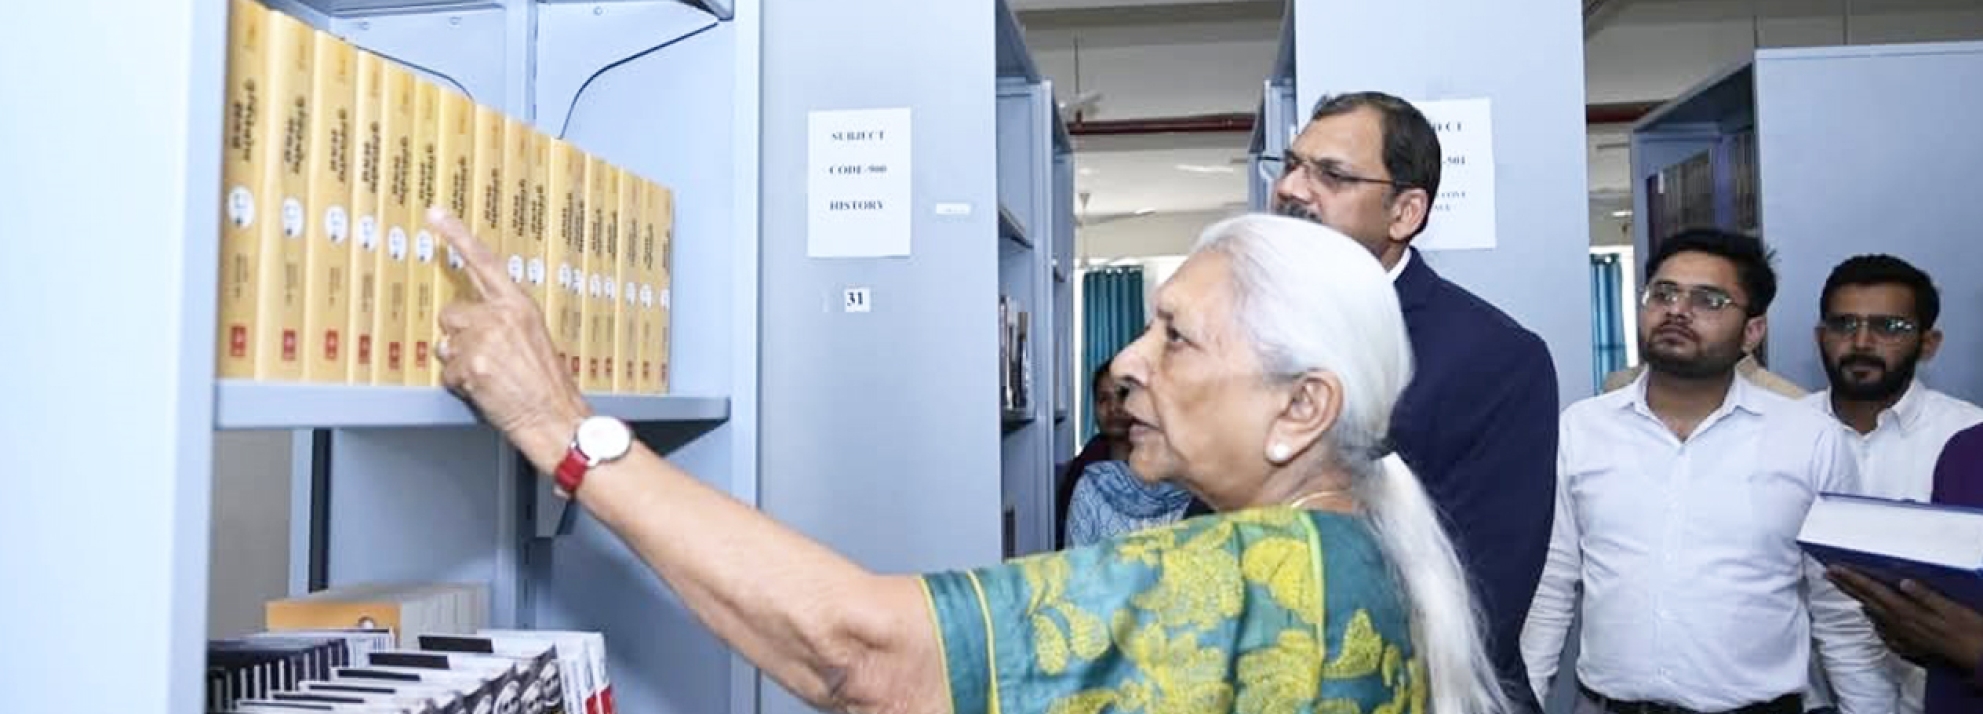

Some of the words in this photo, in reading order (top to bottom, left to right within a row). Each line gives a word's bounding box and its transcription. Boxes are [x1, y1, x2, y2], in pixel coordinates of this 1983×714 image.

[831, 130, 884, 141] SUBJECT
[829, 200, 884, 211] HISTORY
[846, 291, 864, 307] 31
